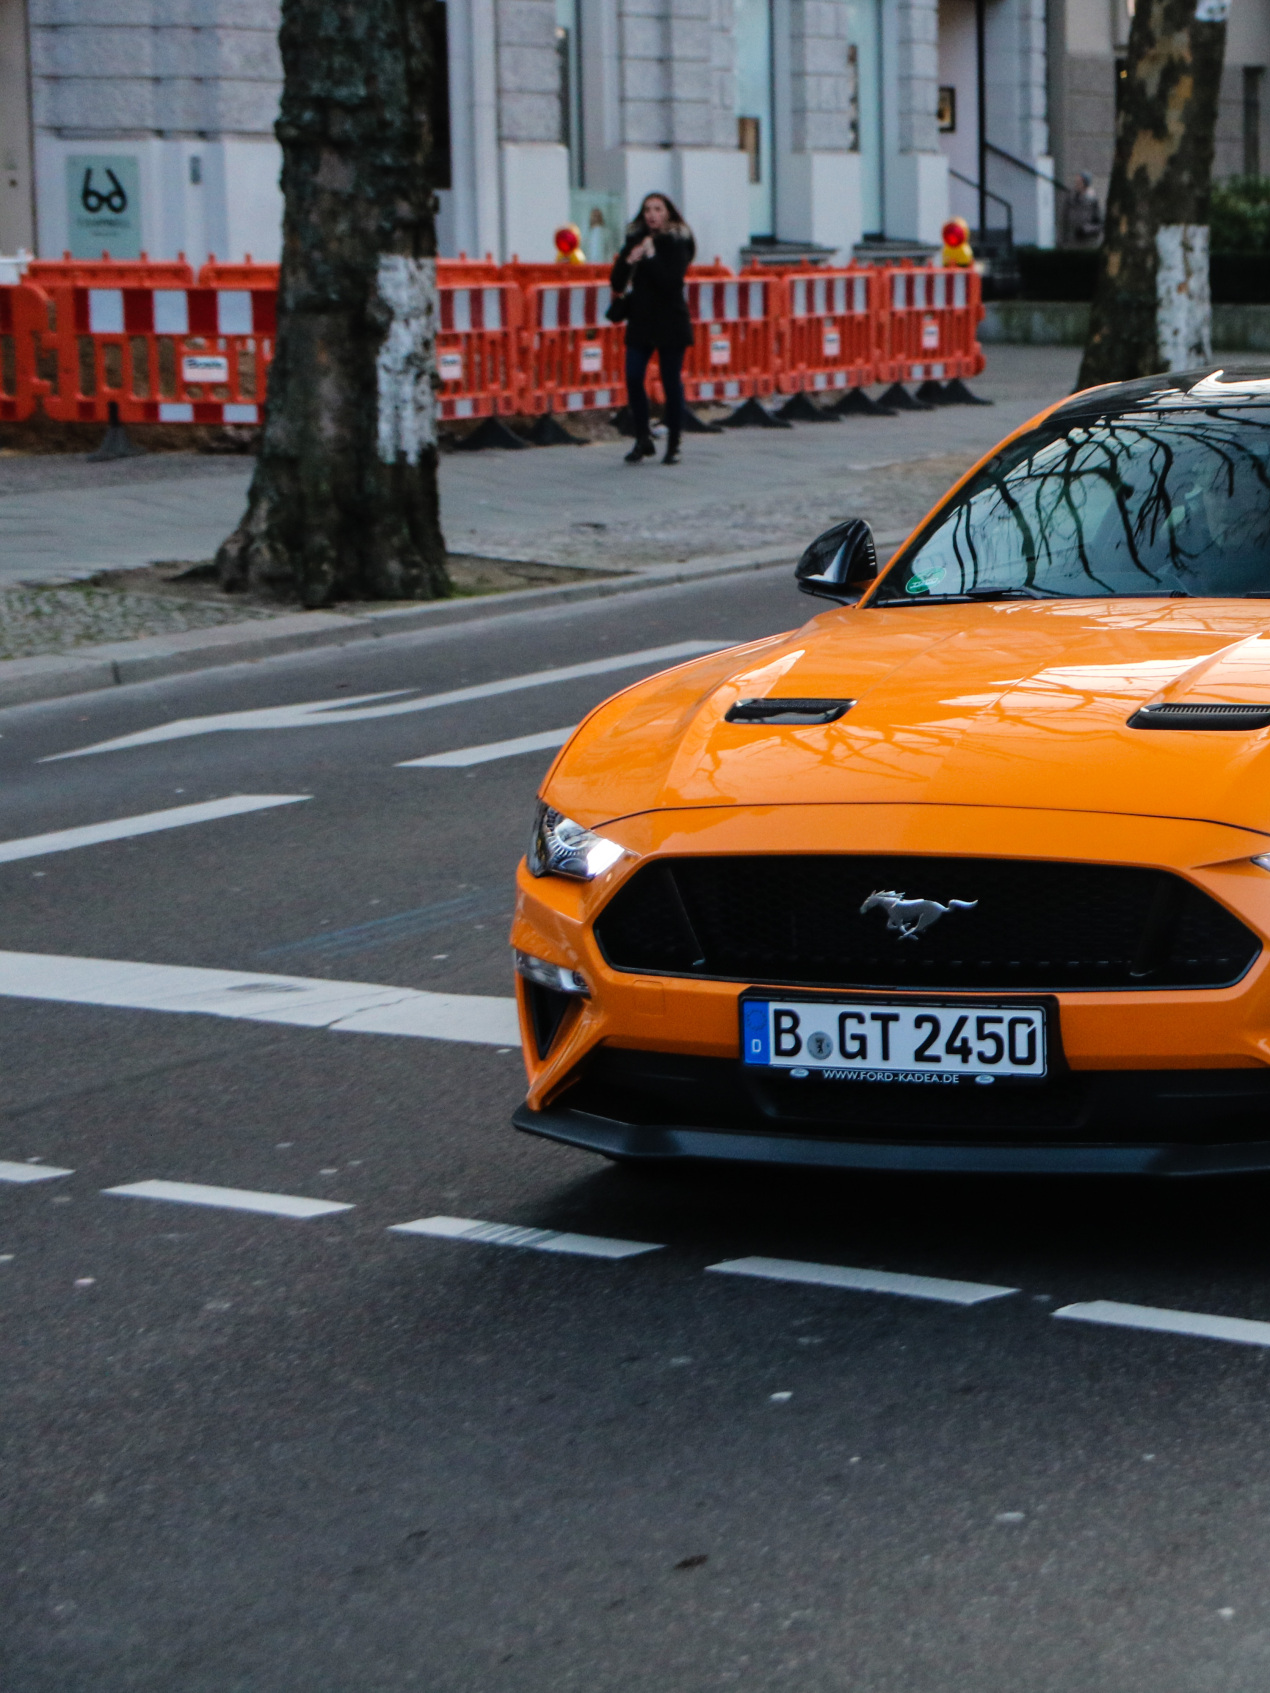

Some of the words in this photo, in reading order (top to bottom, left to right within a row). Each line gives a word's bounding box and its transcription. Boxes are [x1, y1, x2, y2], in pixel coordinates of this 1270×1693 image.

[773, 1008, 803, 1058] B
[838, 1011, 901, 1062] GT
[913, 1013, 1038, 1066] 2450
[751, 1038, 762, 1053] D
[822, 1069, 960, 1084] WWW.FORD-KADEA.DE
